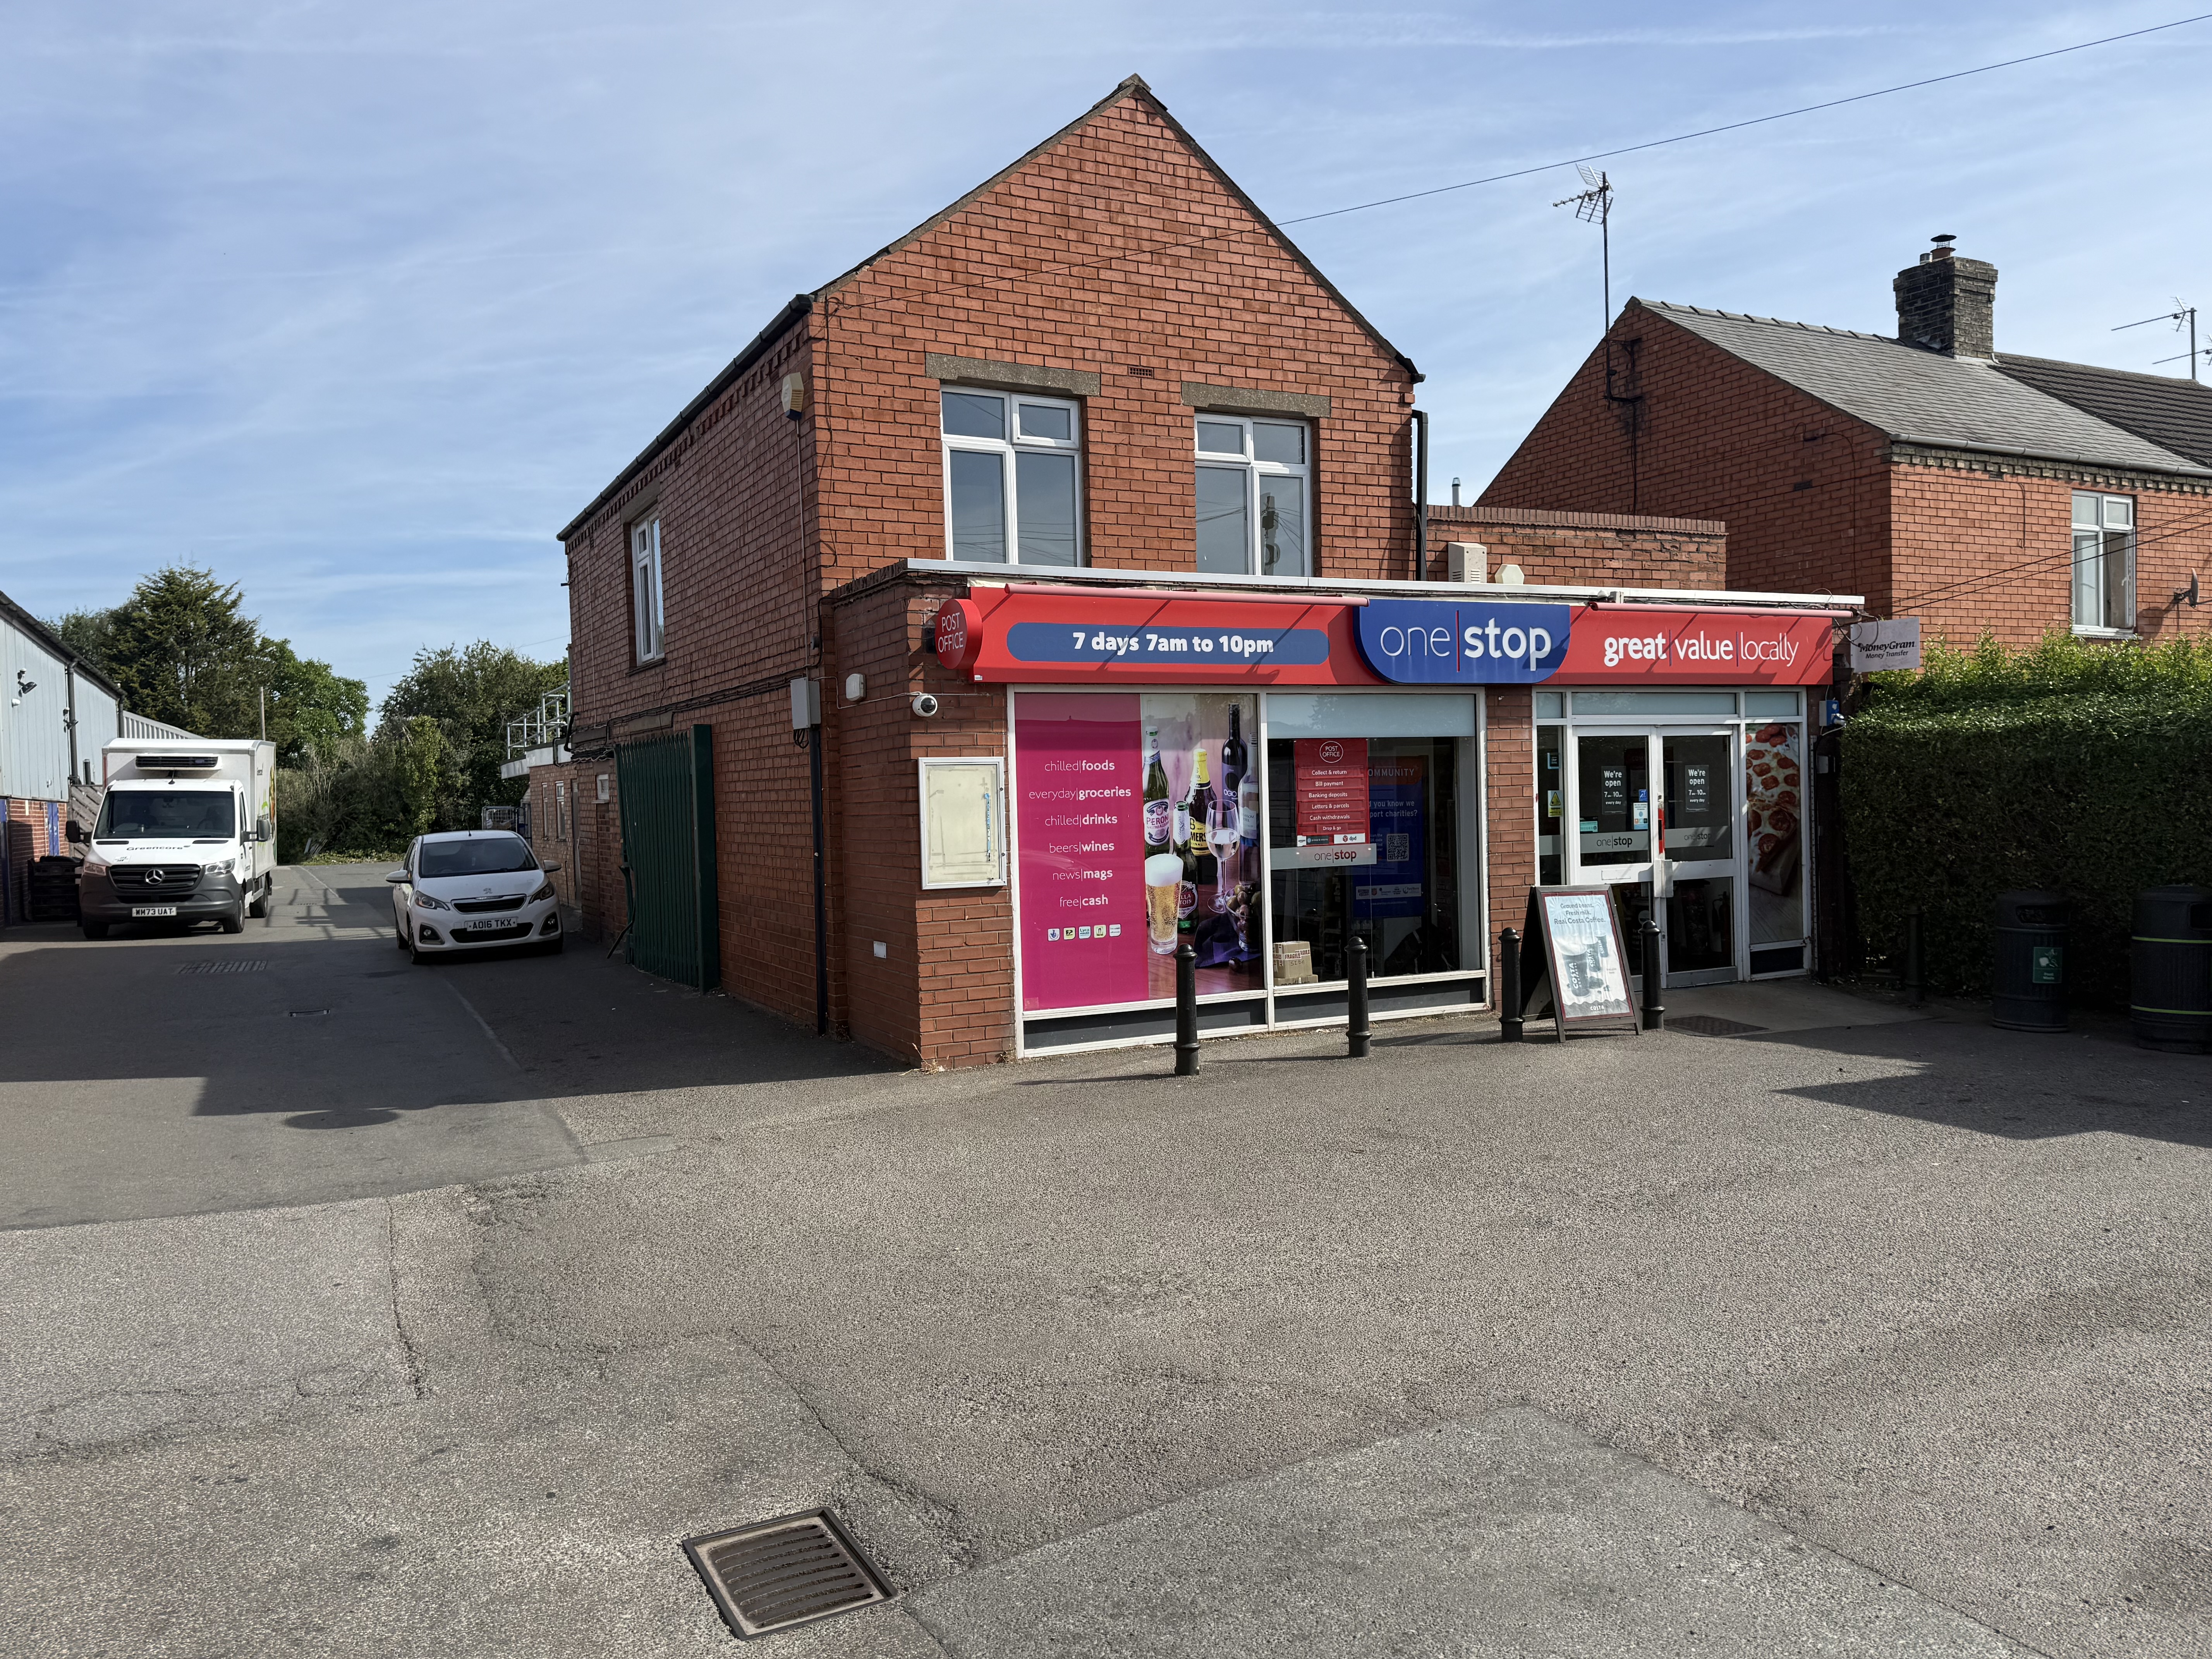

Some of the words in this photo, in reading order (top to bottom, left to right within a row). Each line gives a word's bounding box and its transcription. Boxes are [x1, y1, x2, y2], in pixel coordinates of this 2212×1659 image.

[941, 612, 960, 632] POST
[938, 631, 963, 653] OFFICE
[1072, 632, 1085, 649] 7
[1091, 632, 1139, 656] days
[1146, 634, 1188, 652] 7am
[1192, 636, 1213, 652] to
[1219, 635, 1274, 658] 10pm
[1380, 626, 1451, 657] one
[1464, 617, 1552, 672] stop
[1859, 641, 1915, 652] MoneyGram
[1604, 631, 1666, 667] great
[1674, 630, 1733, 660] value
[1740, 631, 1799, 667] locally
[1044, 760, 1079, 771] chilled
[1082, 759, 1115, 771] foods
[1368, 768, 1415, 777] OMMUNITY
[1604, 770, 1622, 778] We're
[1605, 780, 1621, 788] open
[1029, 787, 1076, 801] everyday
[1079, 786, 1131, 800] groceries
[1045, 814, 1079, 826] chilled
[1082, 813, 1118, 825] drinks
[1191, 832, 1206, 842] MERS
[1614, 836, 1633, 848] stop
[1049, 842, 1079, 853] beers
[1081, 840, 1115, 852] wines
[1314, 852, 1331, 860] one
[1334, 850, 1357, 862] stop
[1053, 871, 1080, 880] news
[1084, 870, 1113, 881] mags
[1060, 896, 1079, 907] free
[1082, 894, 1108, 906] cash
[473, 921, 492, 929] AO16
[495, 919, 512, 927] TKX
[1569, 962, 1579, 989] COSTA
